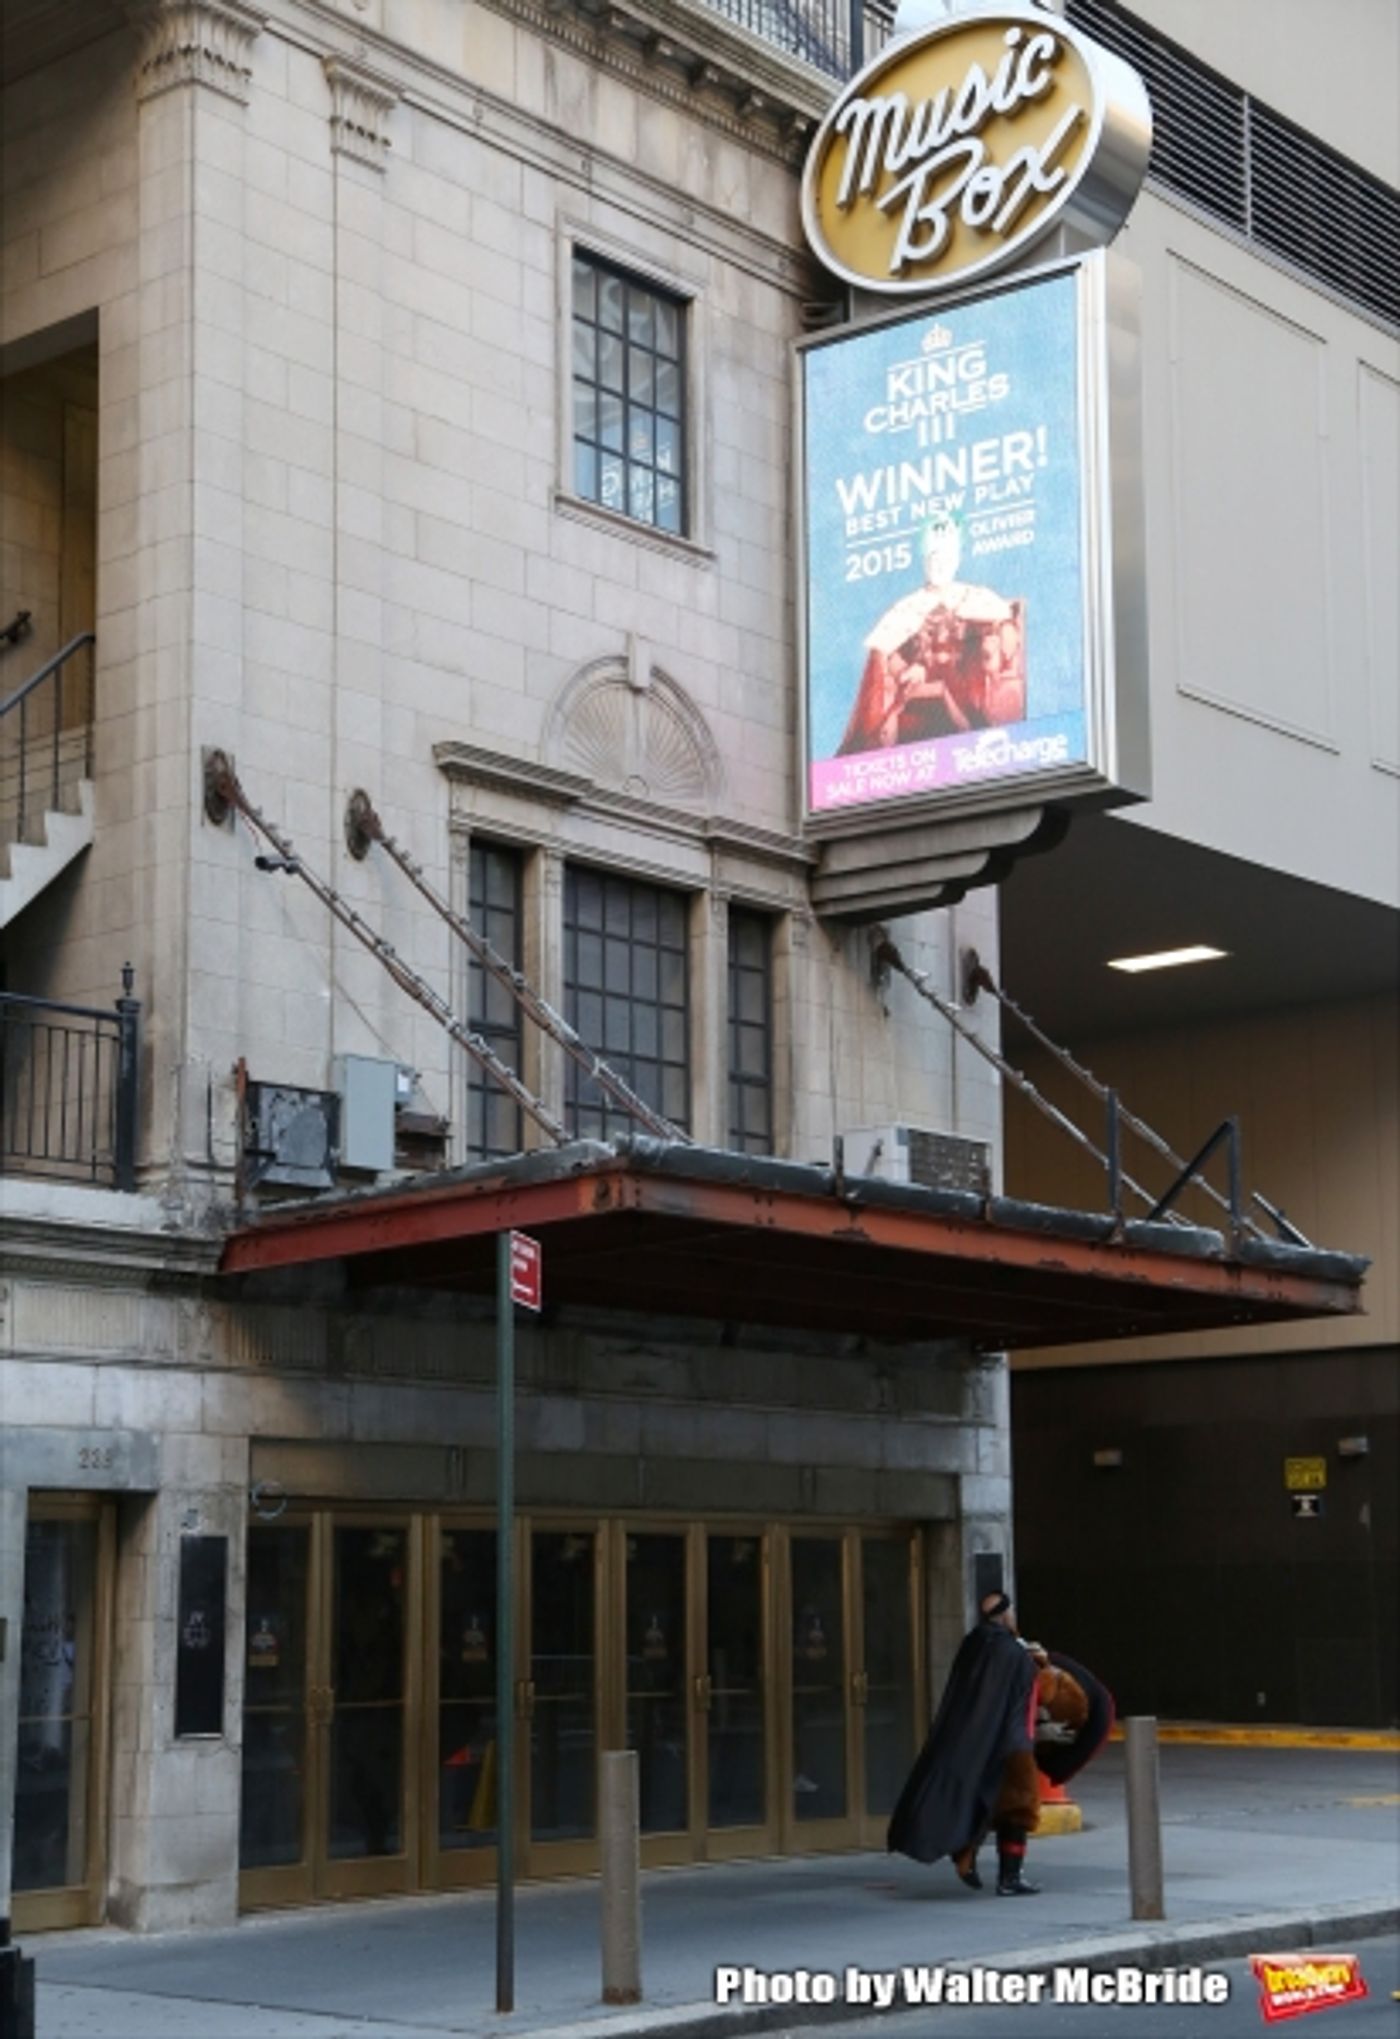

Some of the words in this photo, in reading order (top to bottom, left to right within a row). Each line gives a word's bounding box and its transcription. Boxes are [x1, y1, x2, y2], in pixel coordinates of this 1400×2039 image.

[836, 27, 1057, 205] Music
[875, 105, 1084, 276] Box
[863, 372, 1010, 434] CHARLES
[887, 350, 986, 401] KING
[917, 411, 957, 447] III
[835, 424, 1048, 515] WINNER!
[845, 508, 902, 536] BEST
[910, 490, 967, 520] NEW
[974, 473, 1036, 504] PLAY
[845, 543, 913, 582] 2015
